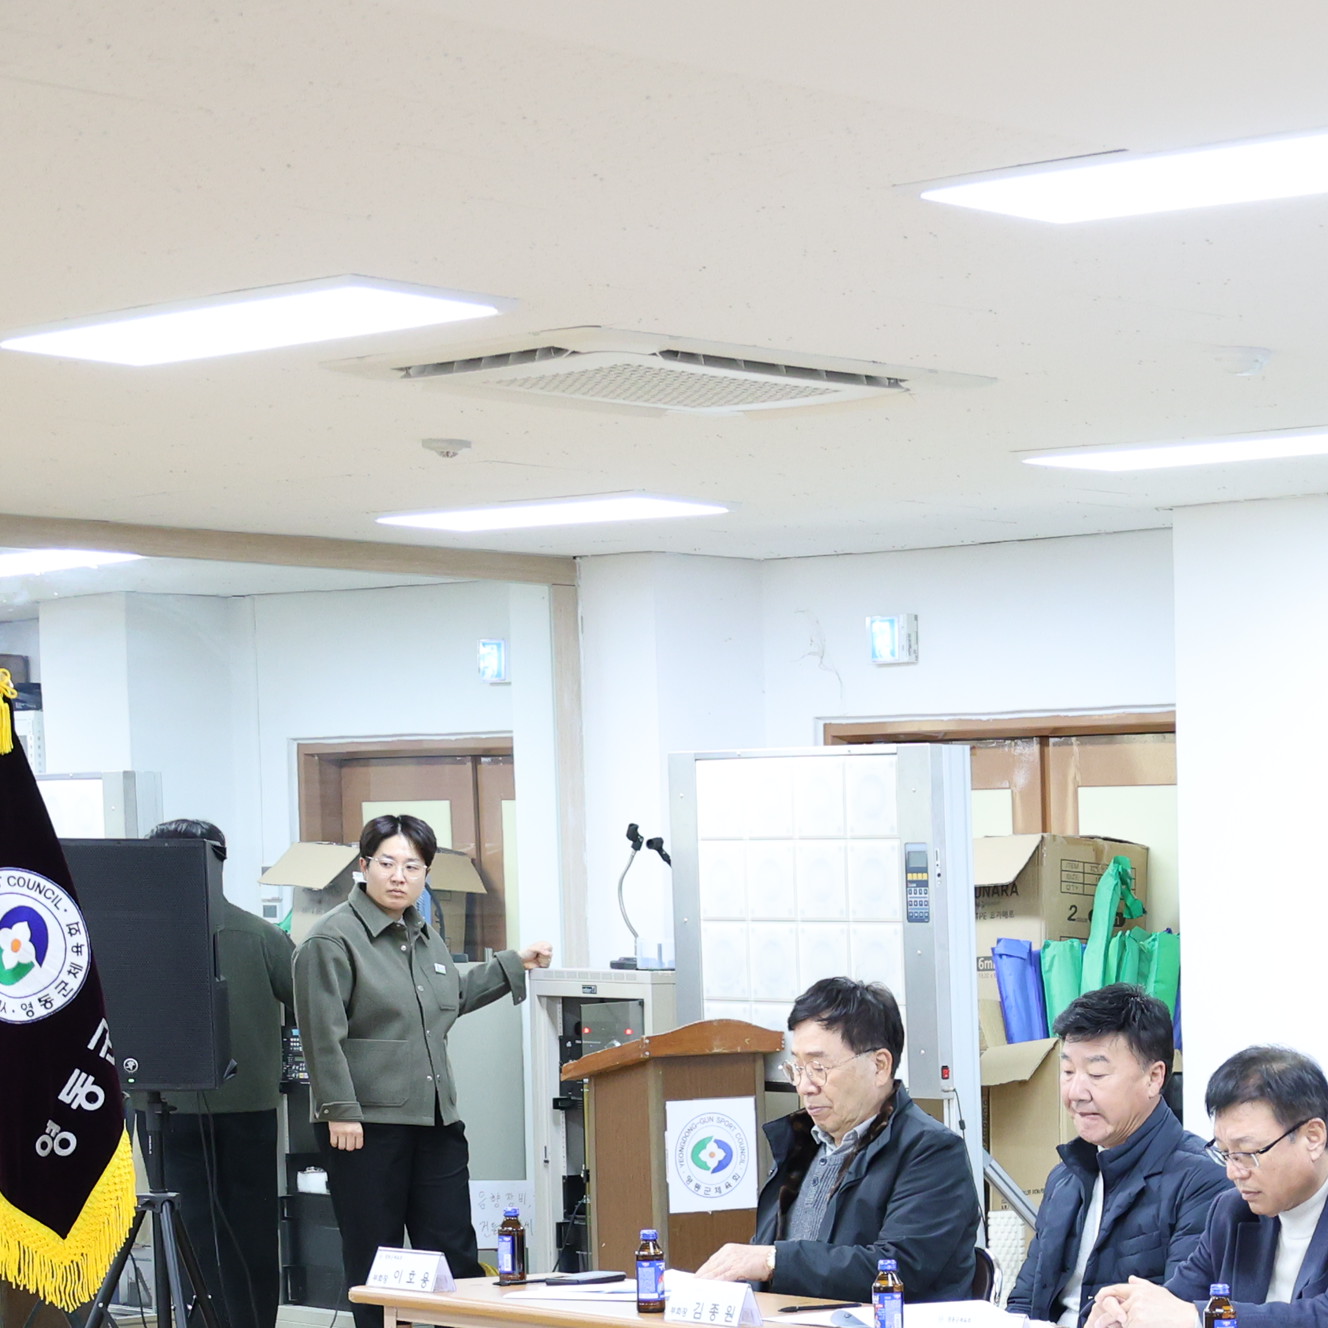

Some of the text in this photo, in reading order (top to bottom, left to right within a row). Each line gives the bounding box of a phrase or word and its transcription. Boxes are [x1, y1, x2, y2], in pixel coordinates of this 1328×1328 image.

[7, 875, 61, 911] COUNCIL
[1067, 904, 1078, 921] 2
[716, 1117, 737, 1132] SPORT
[735, 1132, 745, 1164] COUNCIL
